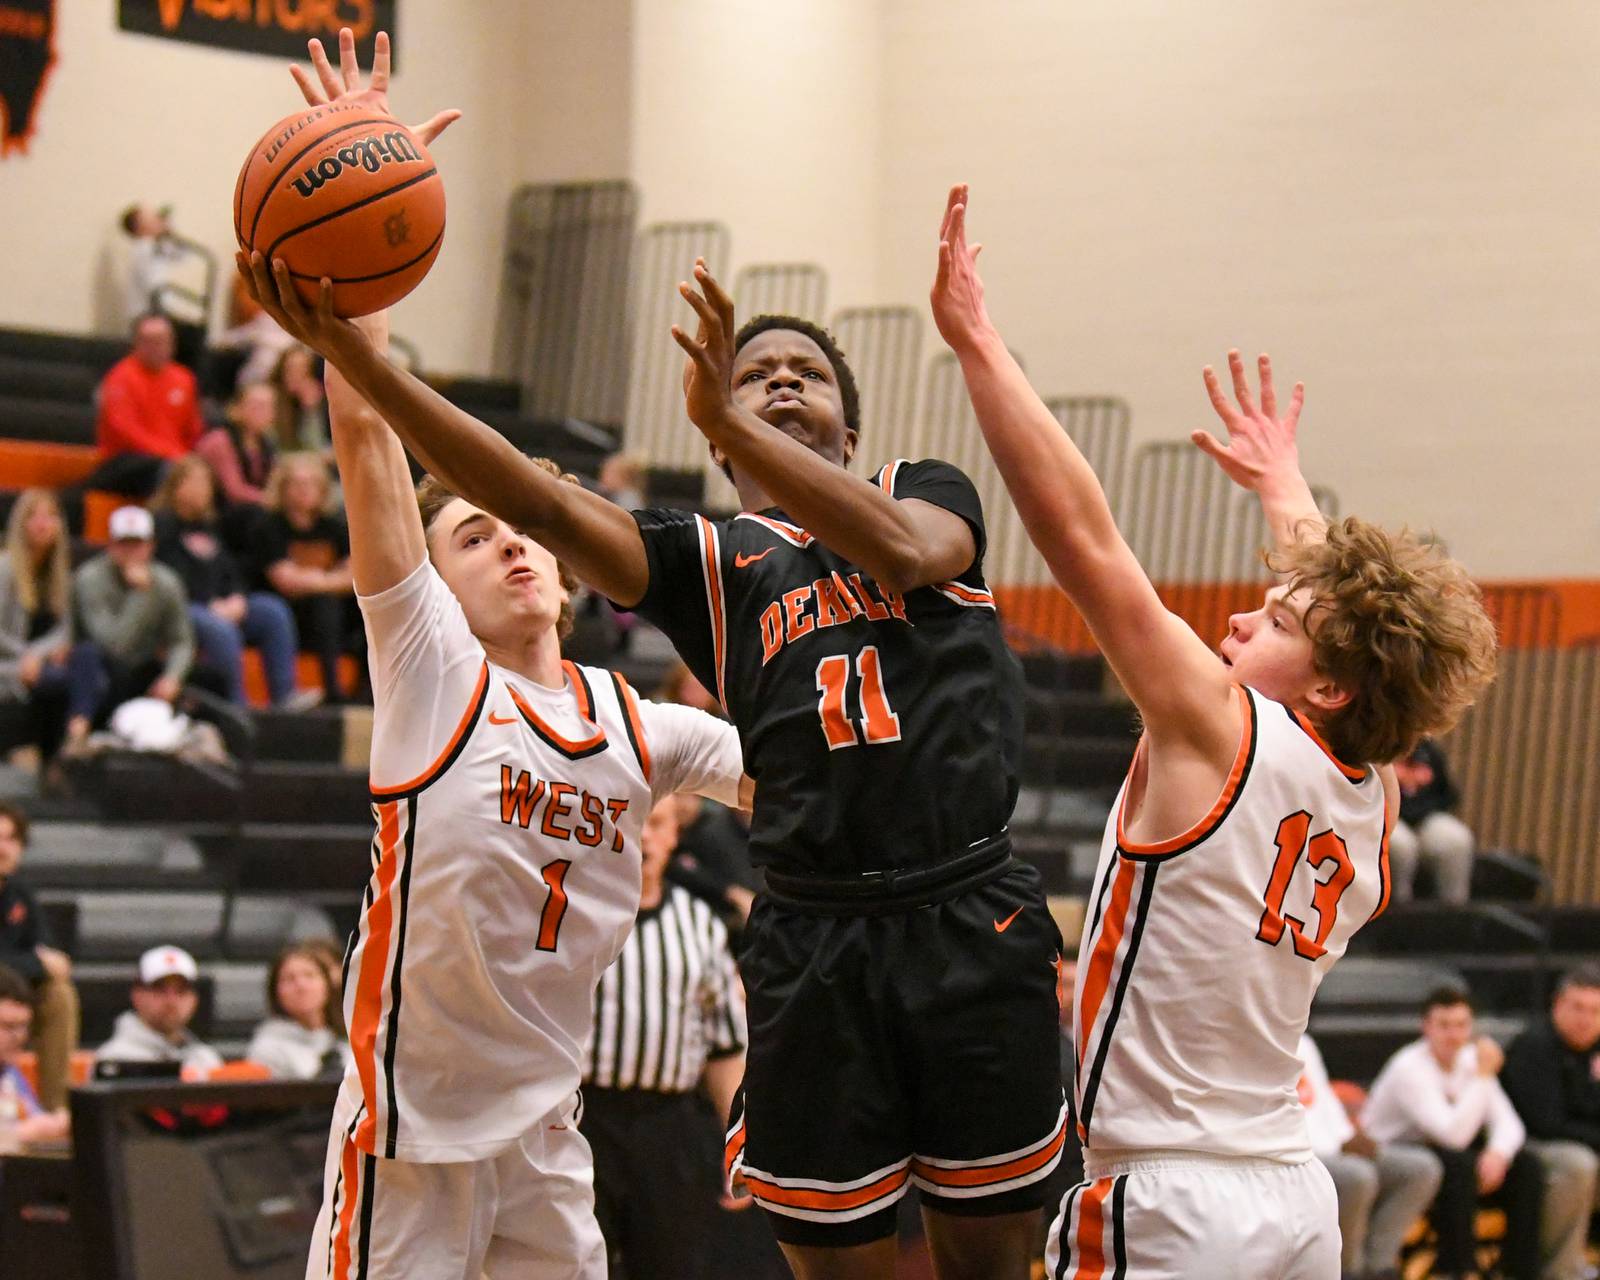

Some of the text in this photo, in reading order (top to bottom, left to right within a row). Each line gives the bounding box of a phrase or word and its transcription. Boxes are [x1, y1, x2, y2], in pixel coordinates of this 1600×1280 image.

[289, 131, 423, 199] Wilson
[816, 645, 901, 751] 11
[500, 764, 629, 854] WEST
[535, 858, 572, 953] 1
[1255, 809, 1356, 962] 13
